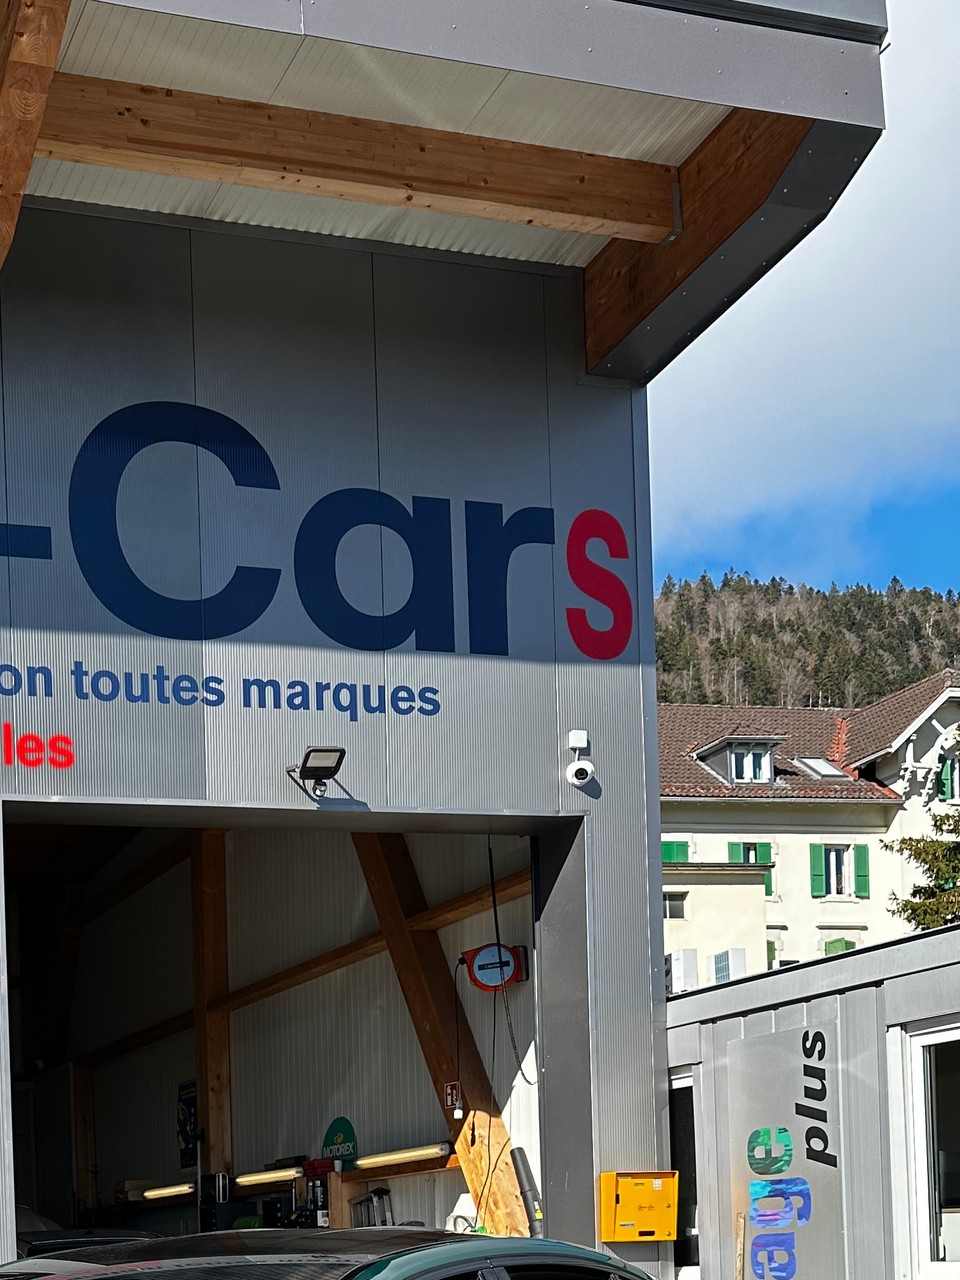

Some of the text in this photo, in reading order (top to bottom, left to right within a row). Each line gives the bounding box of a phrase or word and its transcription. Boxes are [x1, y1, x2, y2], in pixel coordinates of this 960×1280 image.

[71, 660, 225, 709] toutes
[242, 678, 441, 722] marques
[795, 1029, 838, 1168] plus
[323, 1141, 356, 1158] MOTOREX
